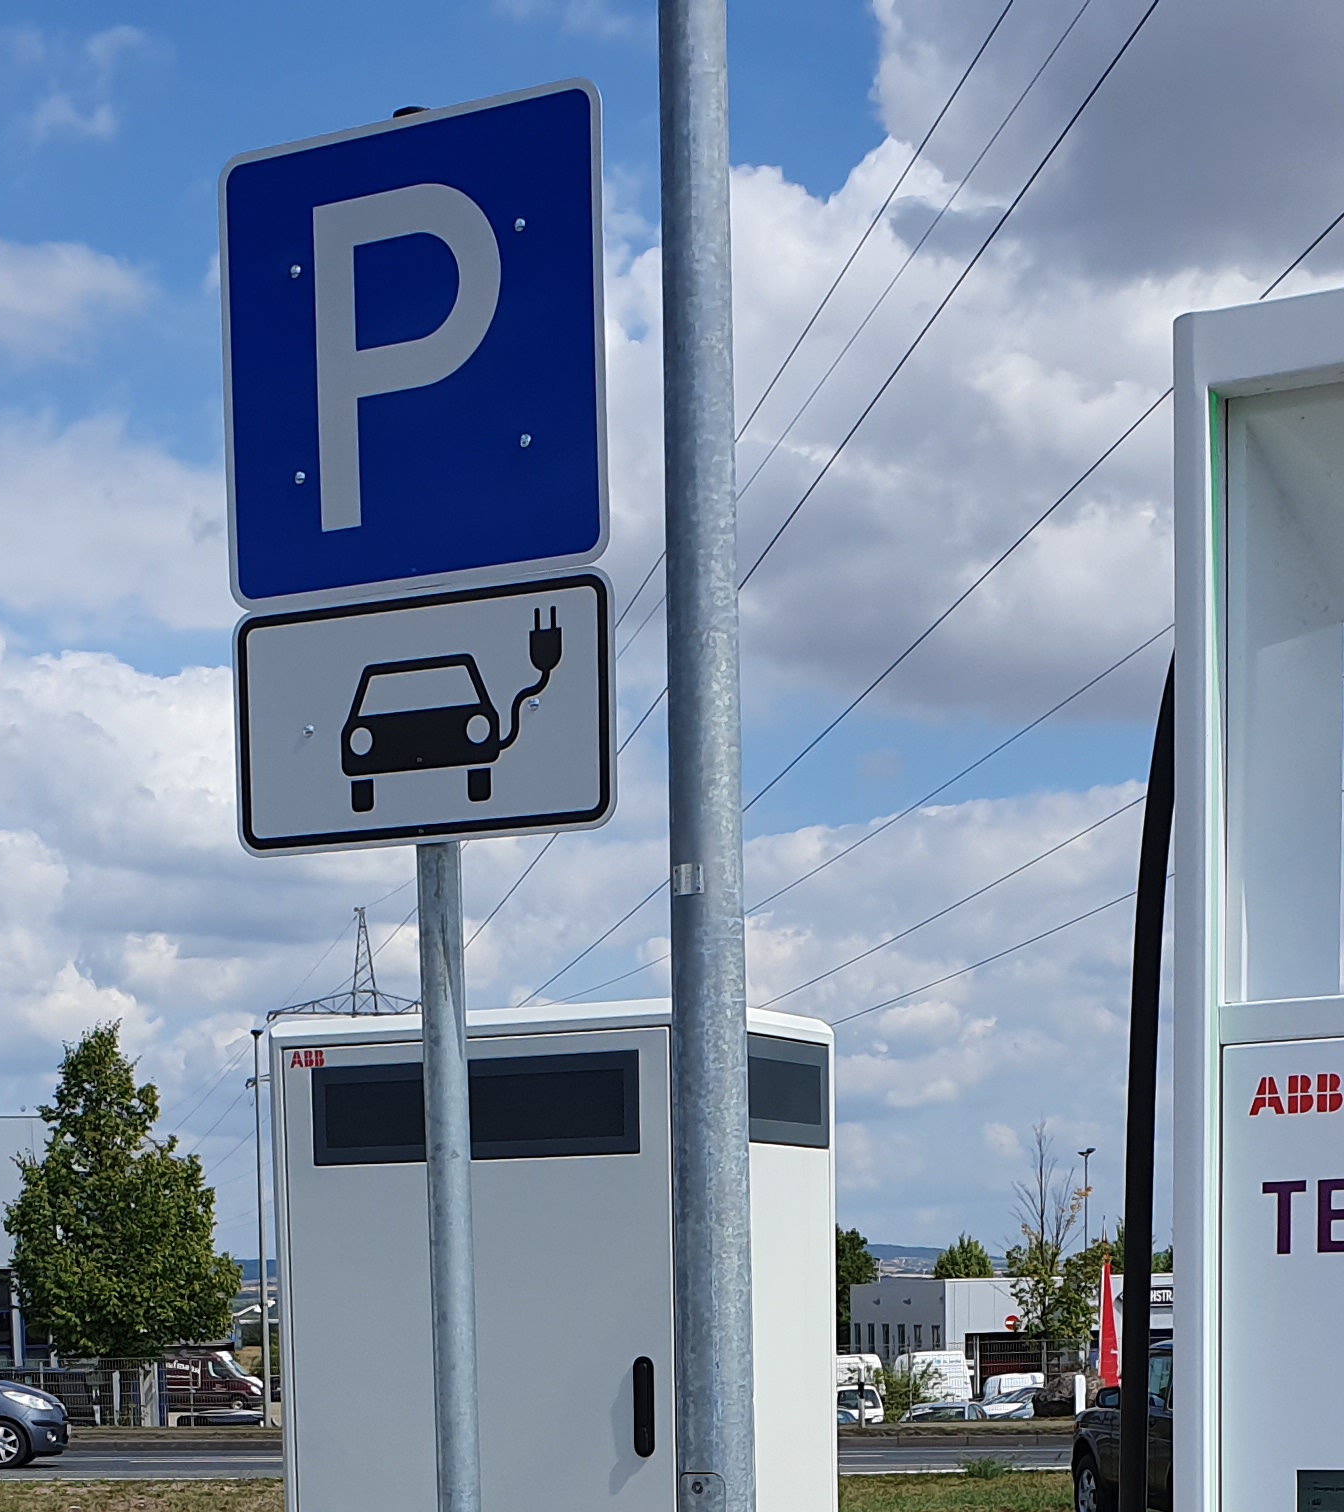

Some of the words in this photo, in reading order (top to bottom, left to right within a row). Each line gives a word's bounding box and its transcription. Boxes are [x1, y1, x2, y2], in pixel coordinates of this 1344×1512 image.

[313, 182, 502, 533] P
[290, 1050, 325, 1069] ABB
[1249, 1073, 1344, 1116] ABB
